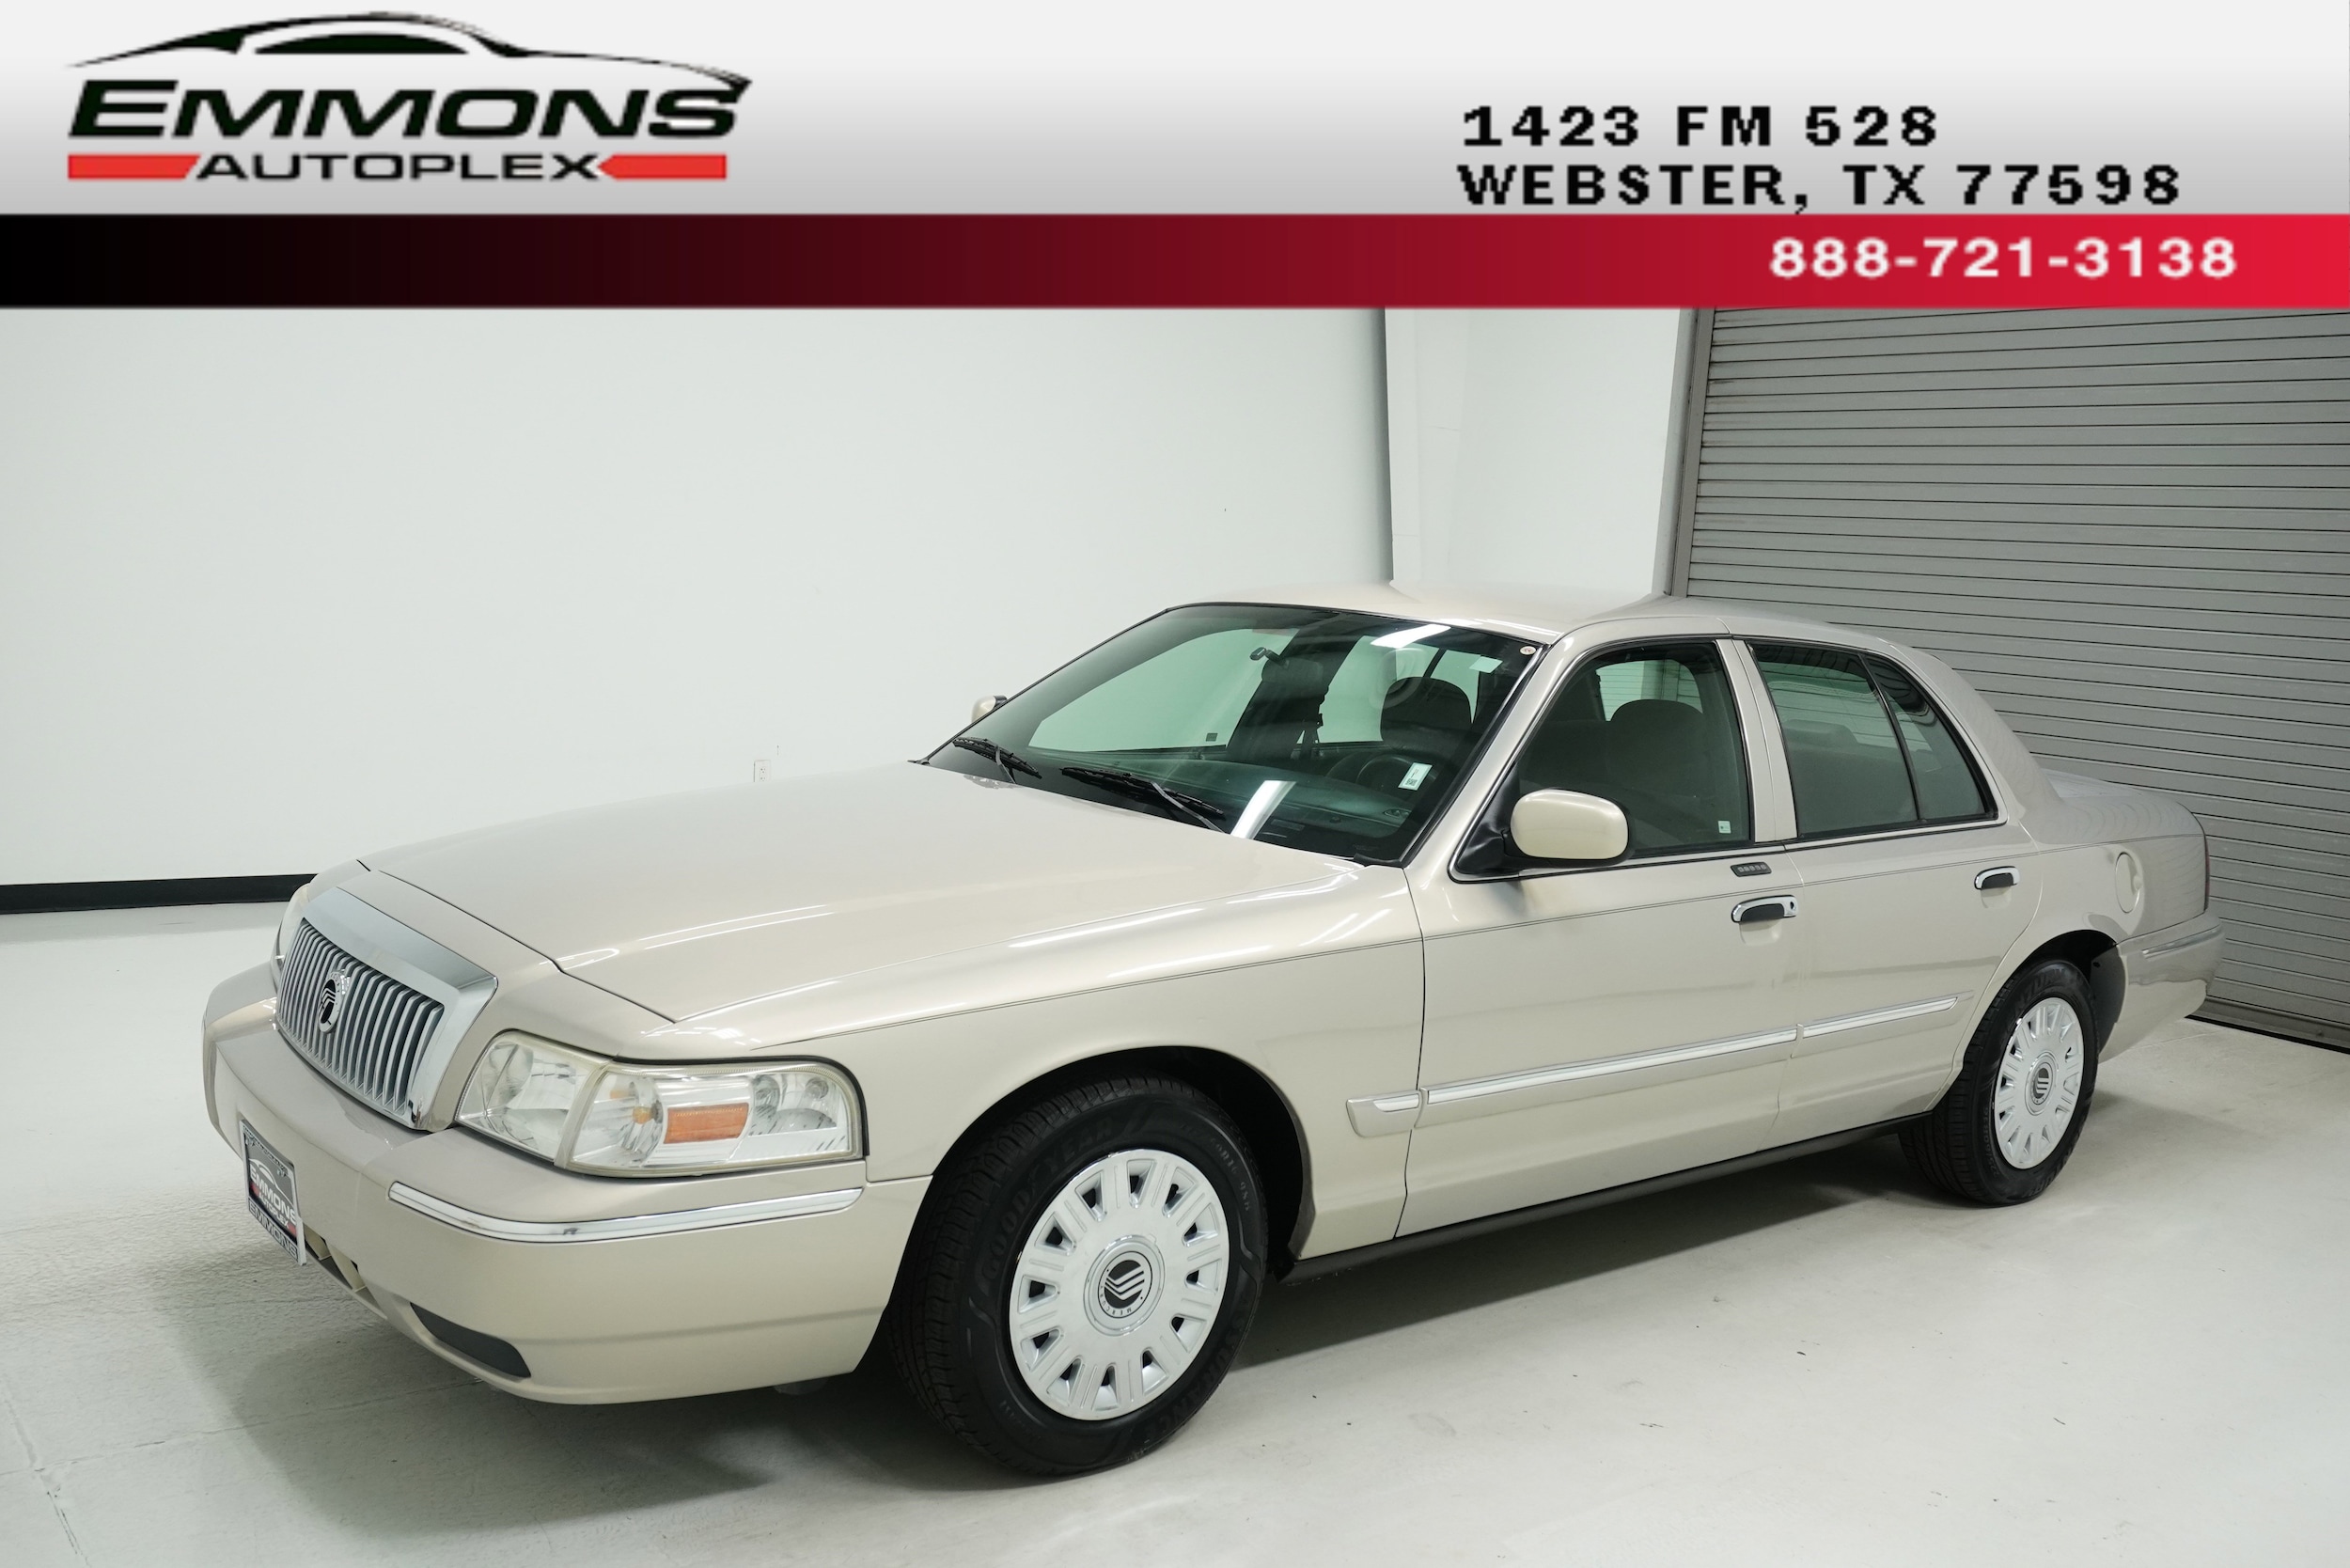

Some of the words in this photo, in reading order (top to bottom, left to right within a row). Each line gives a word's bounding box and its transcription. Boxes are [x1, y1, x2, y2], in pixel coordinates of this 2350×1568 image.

[249, 1163, 297, 1226] EMMONS
[981, 1116, 1114, 1281] GOODYEAR
[249, 1201, 298, 1258] EMMONS
